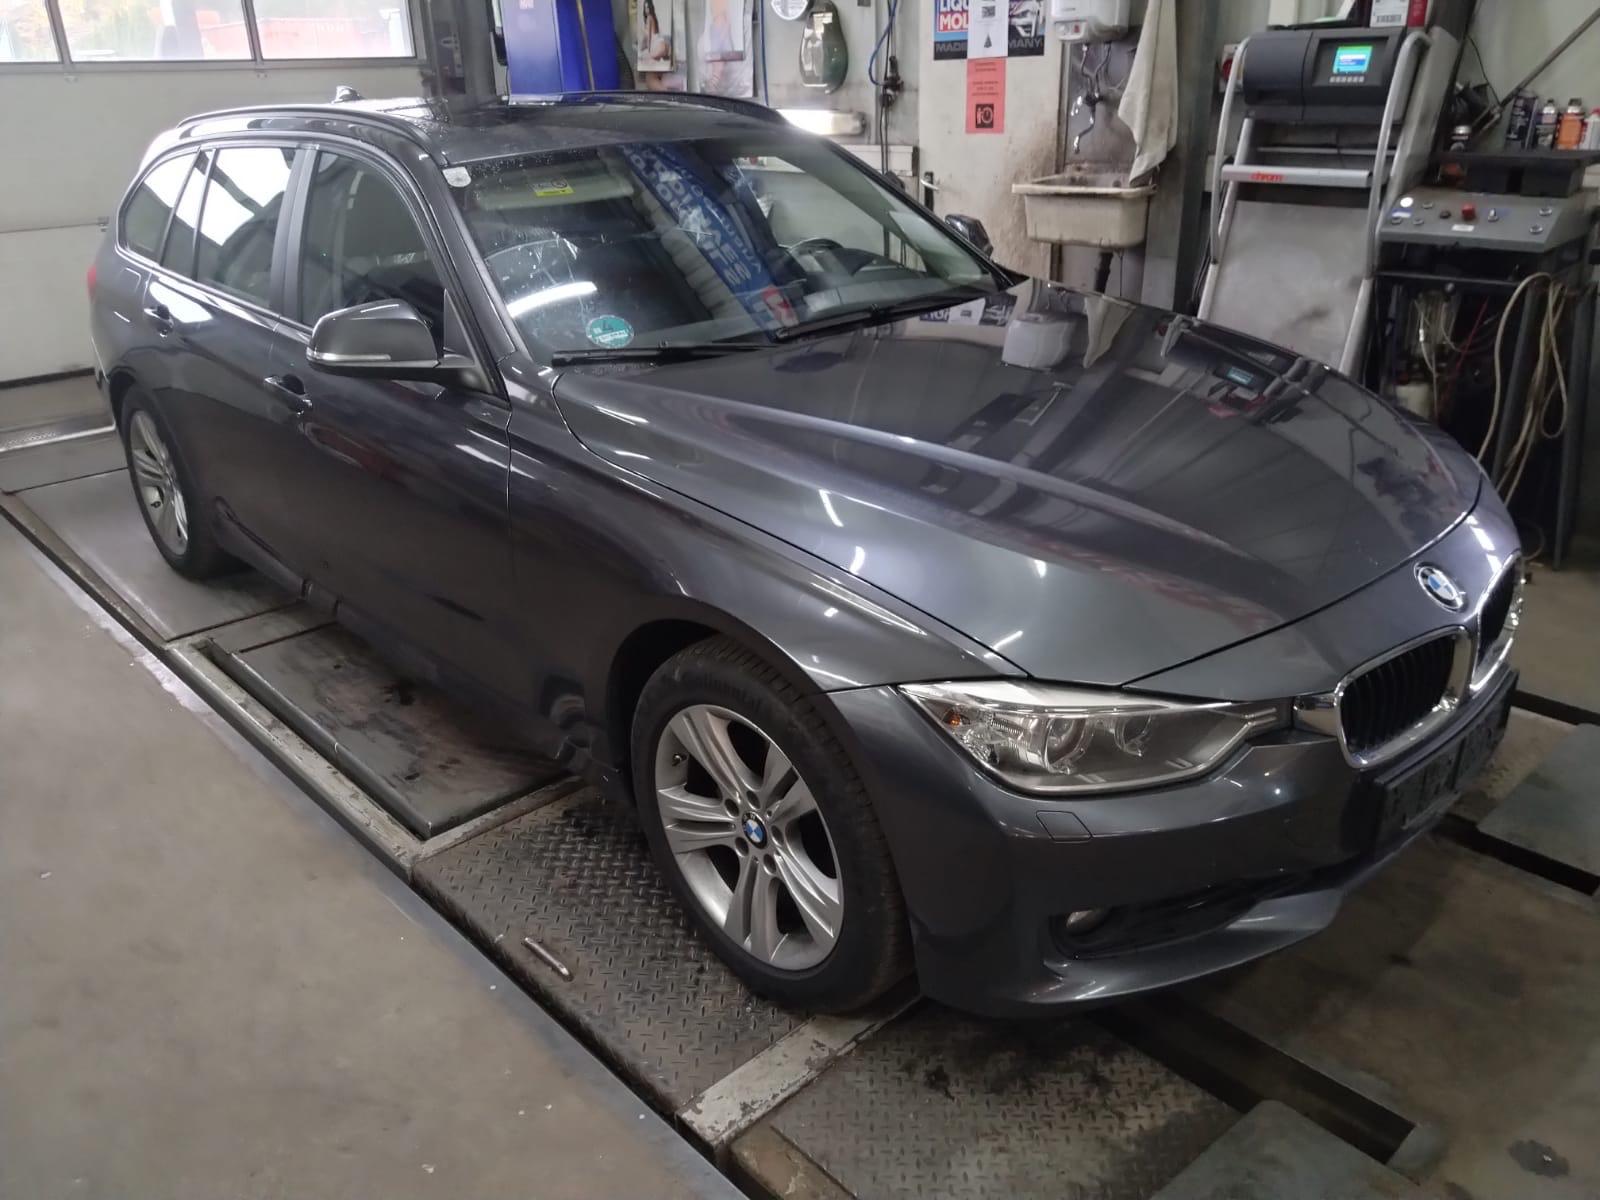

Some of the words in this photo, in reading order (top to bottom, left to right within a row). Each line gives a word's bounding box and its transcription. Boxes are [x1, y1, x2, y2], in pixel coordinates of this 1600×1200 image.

[940, 0, 968, 12] LIQU
[940, 12, 968, 30] MOL
[1008, 38, 1042, 49] MANY
